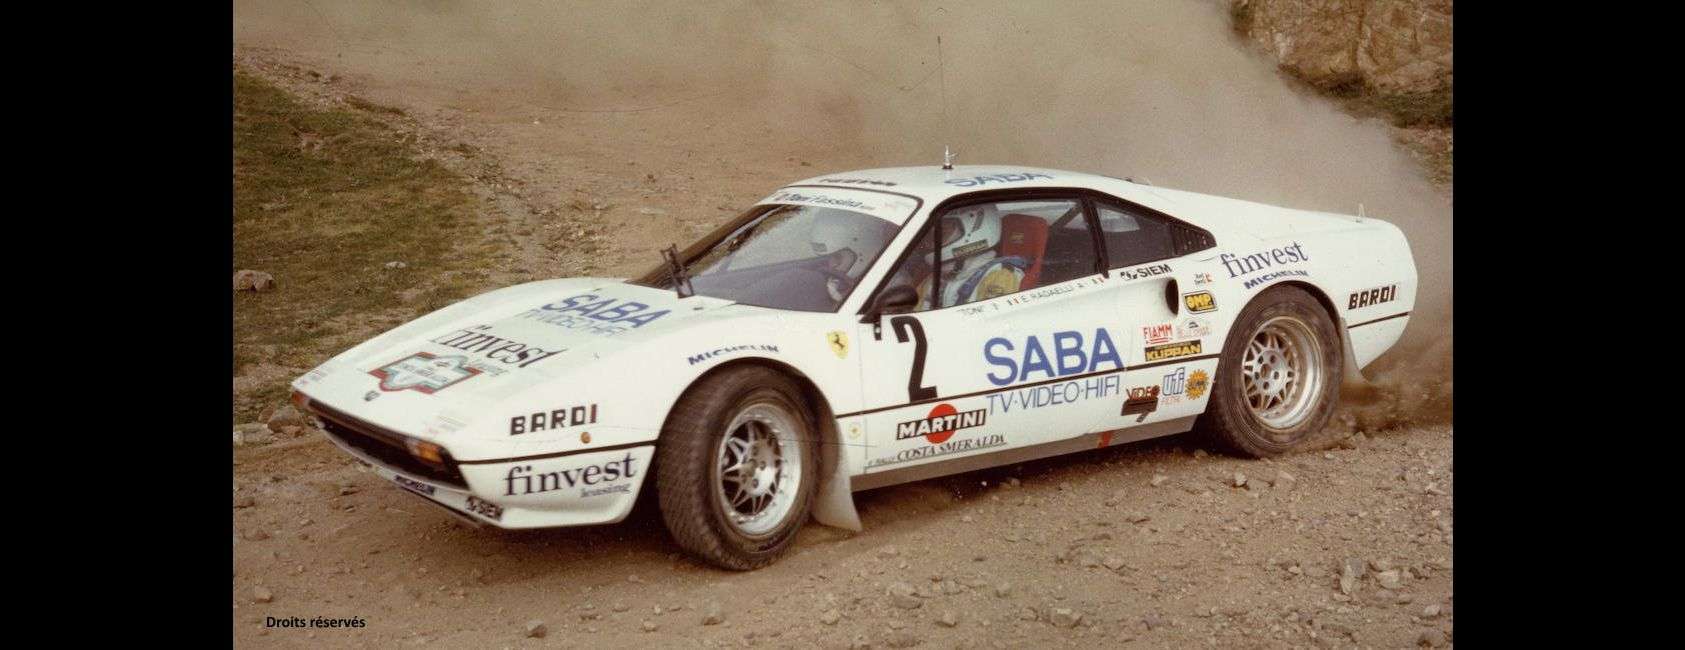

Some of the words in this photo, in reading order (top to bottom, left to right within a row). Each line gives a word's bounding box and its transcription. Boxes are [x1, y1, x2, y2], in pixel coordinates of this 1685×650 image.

[944, 173, 1053, 187] SABA
[1136, 264, 1172, 278] SIEM
[1220, 241, 1308, 277] finvest
[1244, 269, 1309, 290] MICHELIN
[542, 294, 672, 328] SABA
[1348, 285, 1396, 310] BARDI
[429, 325, 568, 368] finvest
[1143, 324, 1173, 339] FIAMM
[890, 316, 938, 404] 2
[984, 327, 1124, 387] SABA
[510, 404, 597, 435] BARDI
[899, 410, 984, 439] MARTINI
[898, 444, 935, 462] COSTA
[939, 434, 1006, 454] SMERALDA
[503, 452, 637, 496] finvest
